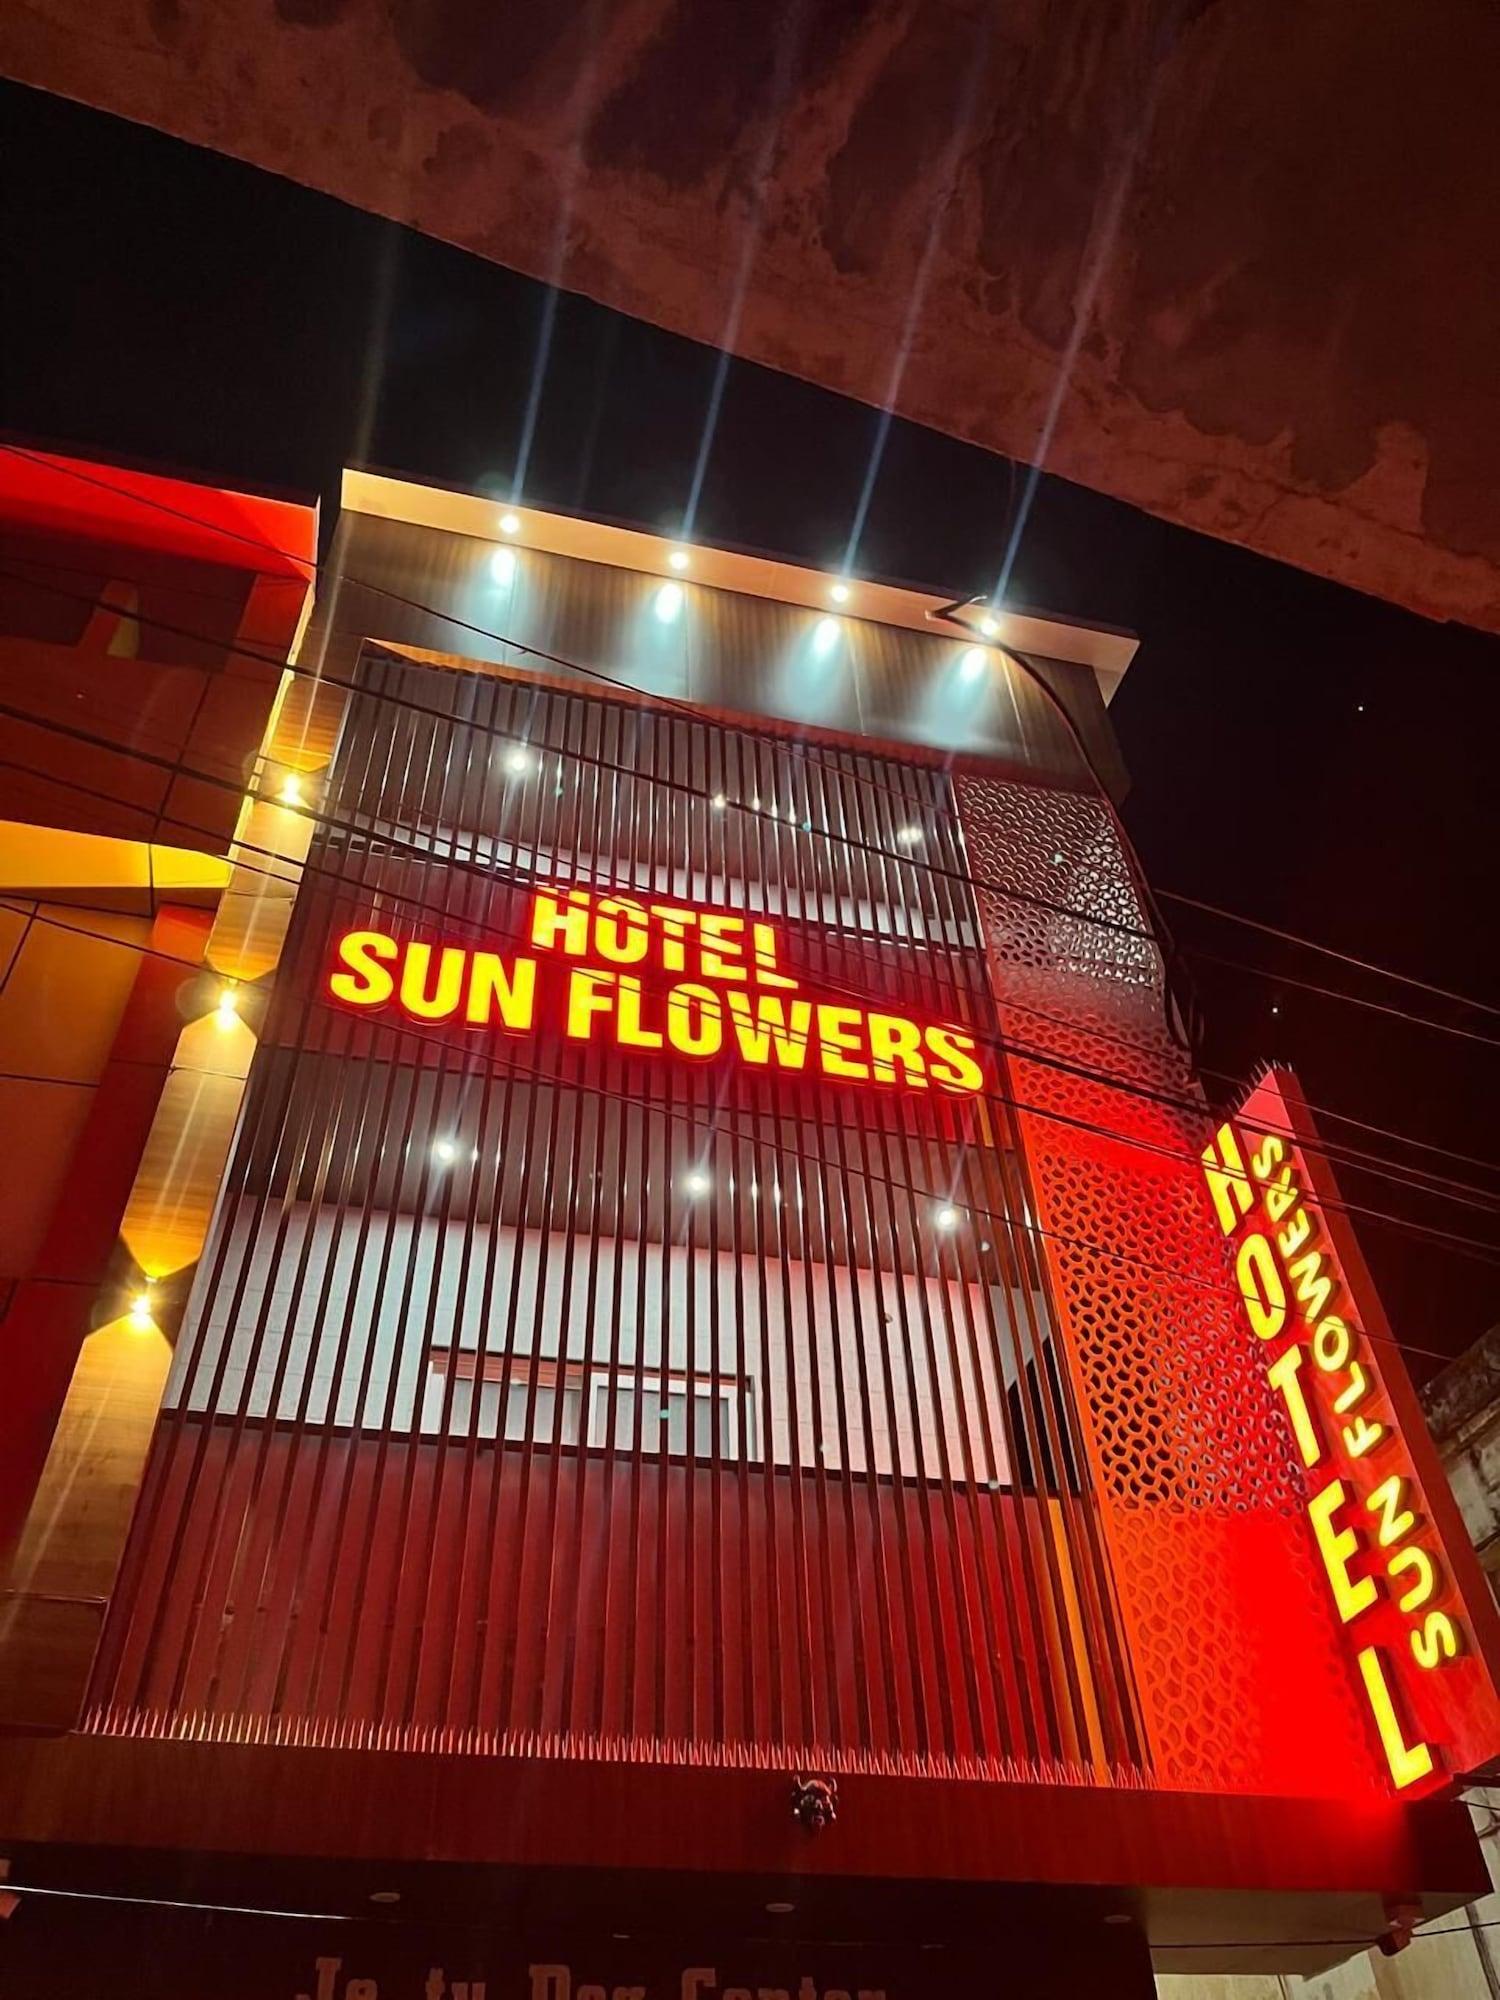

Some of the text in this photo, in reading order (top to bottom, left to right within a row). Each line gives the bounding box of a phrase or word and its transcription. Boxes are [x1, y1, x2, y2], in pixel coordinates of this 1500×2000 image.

[329, 930, 985, 1092] SUN FLOWERS
[530, 886, 798, 990] HOTEL
[1201, 1122, 1435, 1790] HOTEL
[1252, 1135, 1458, 1670] SUN FLOWERS
